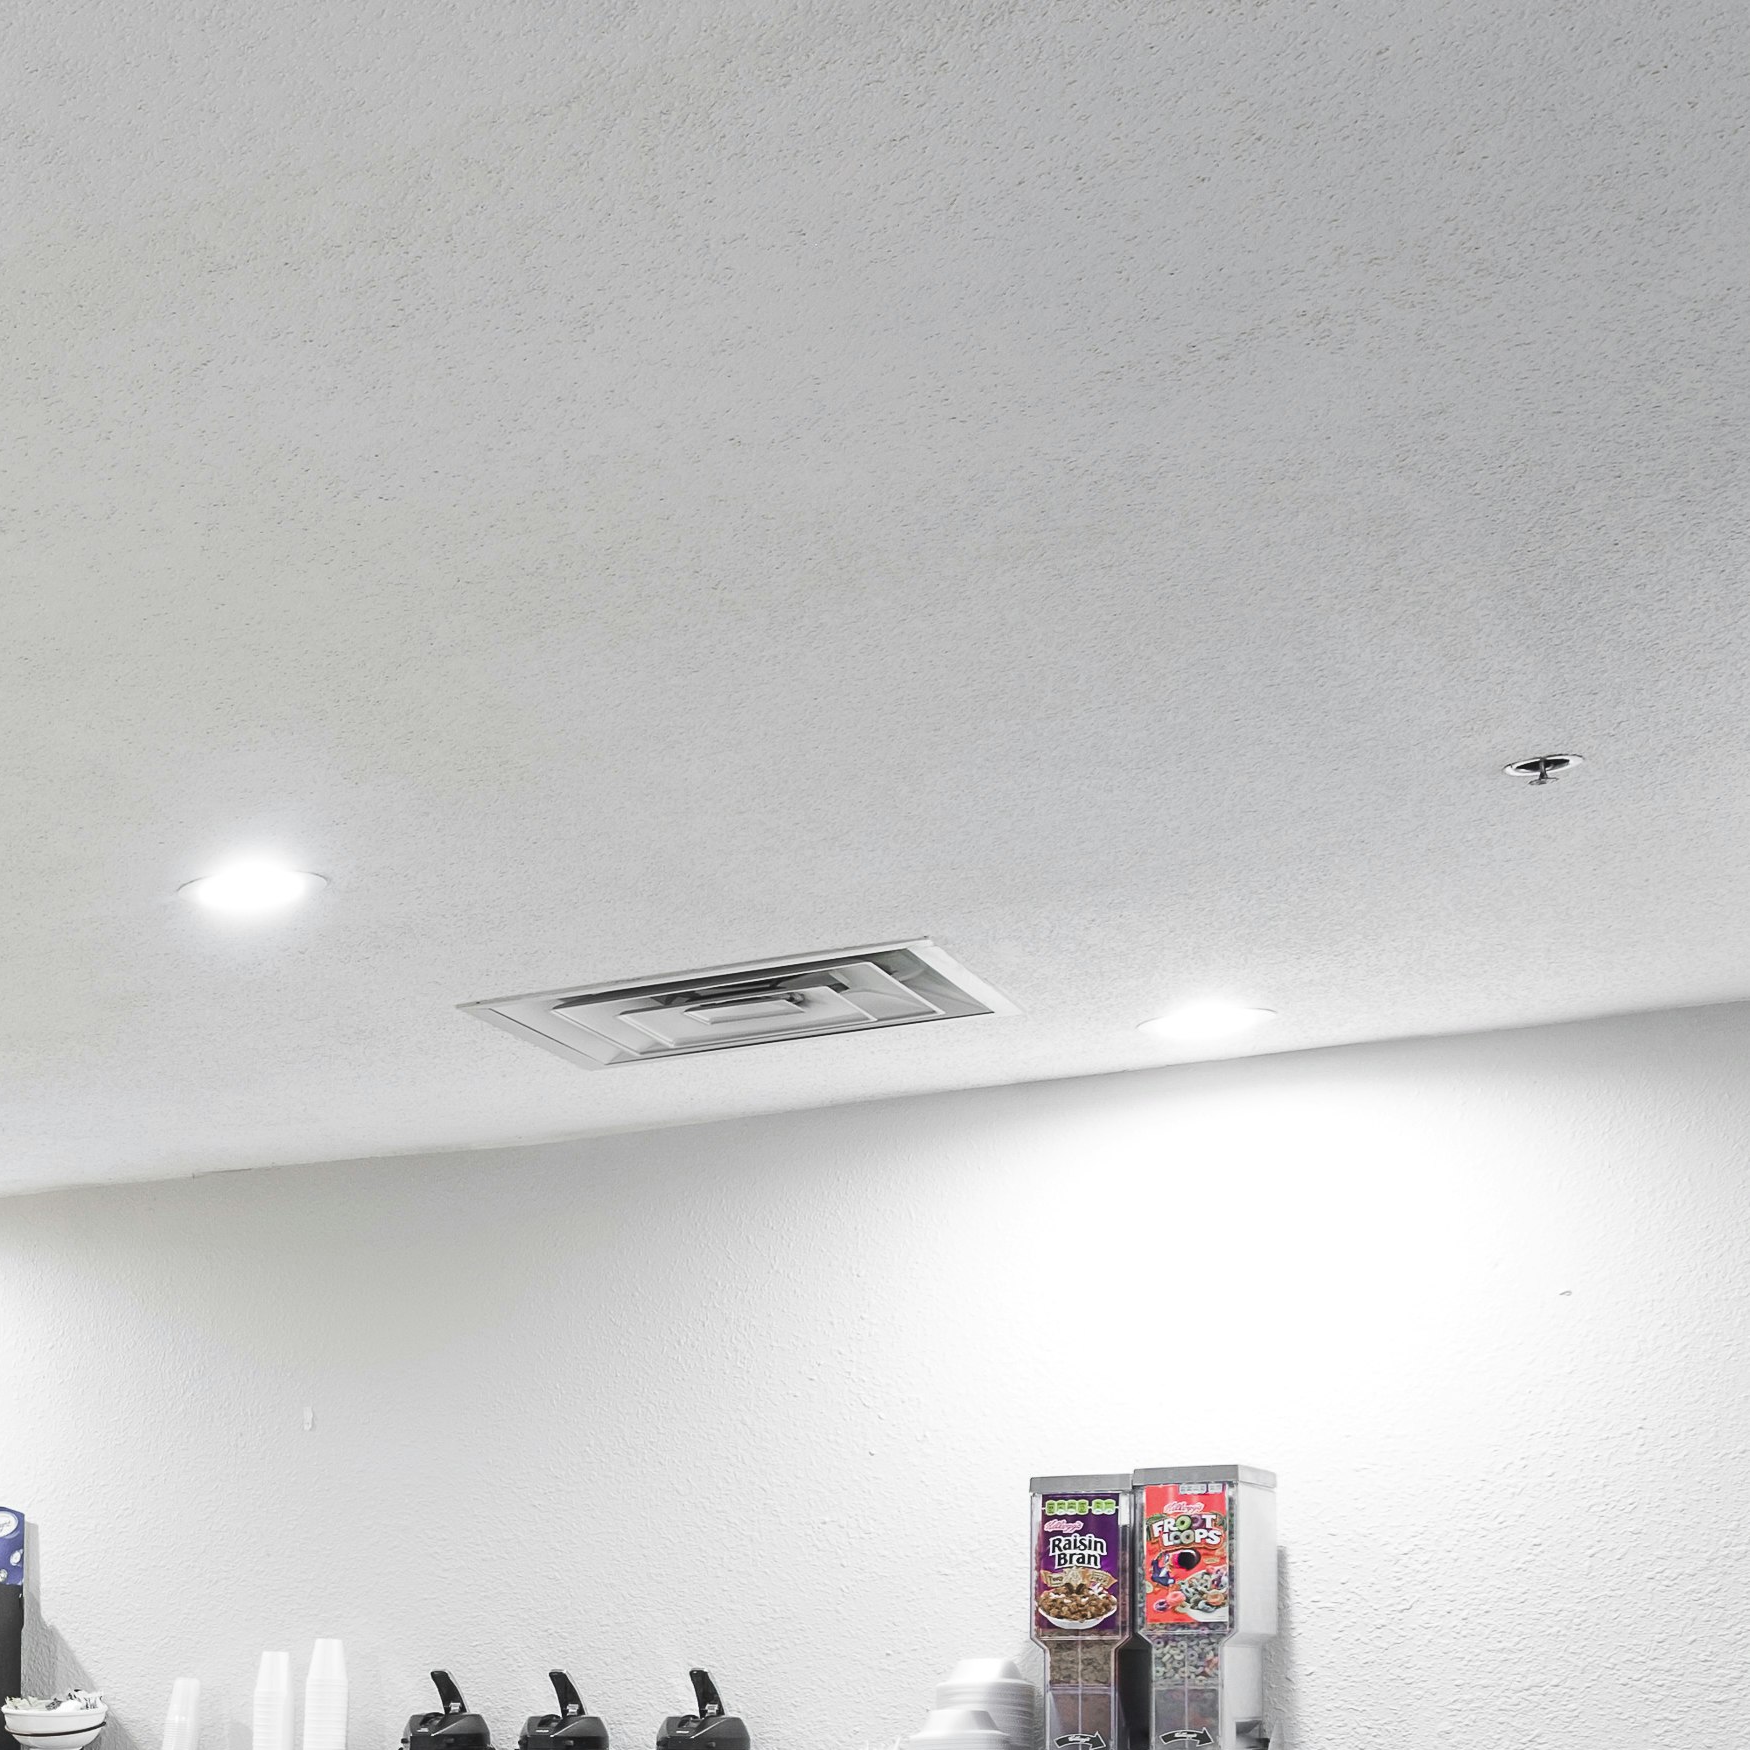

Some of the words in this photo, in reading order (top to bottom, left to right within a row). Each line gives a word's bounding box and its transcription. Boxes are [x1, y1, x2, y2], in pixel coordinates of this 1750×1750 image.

[1152, 1515, 1216, 1537] FROOT
[1050, 1535, 1106, 1555] Raisin
[1162, 1529, 1221, 1546] LOOPS
[1057, 1552, 1099, 1567] Bran
